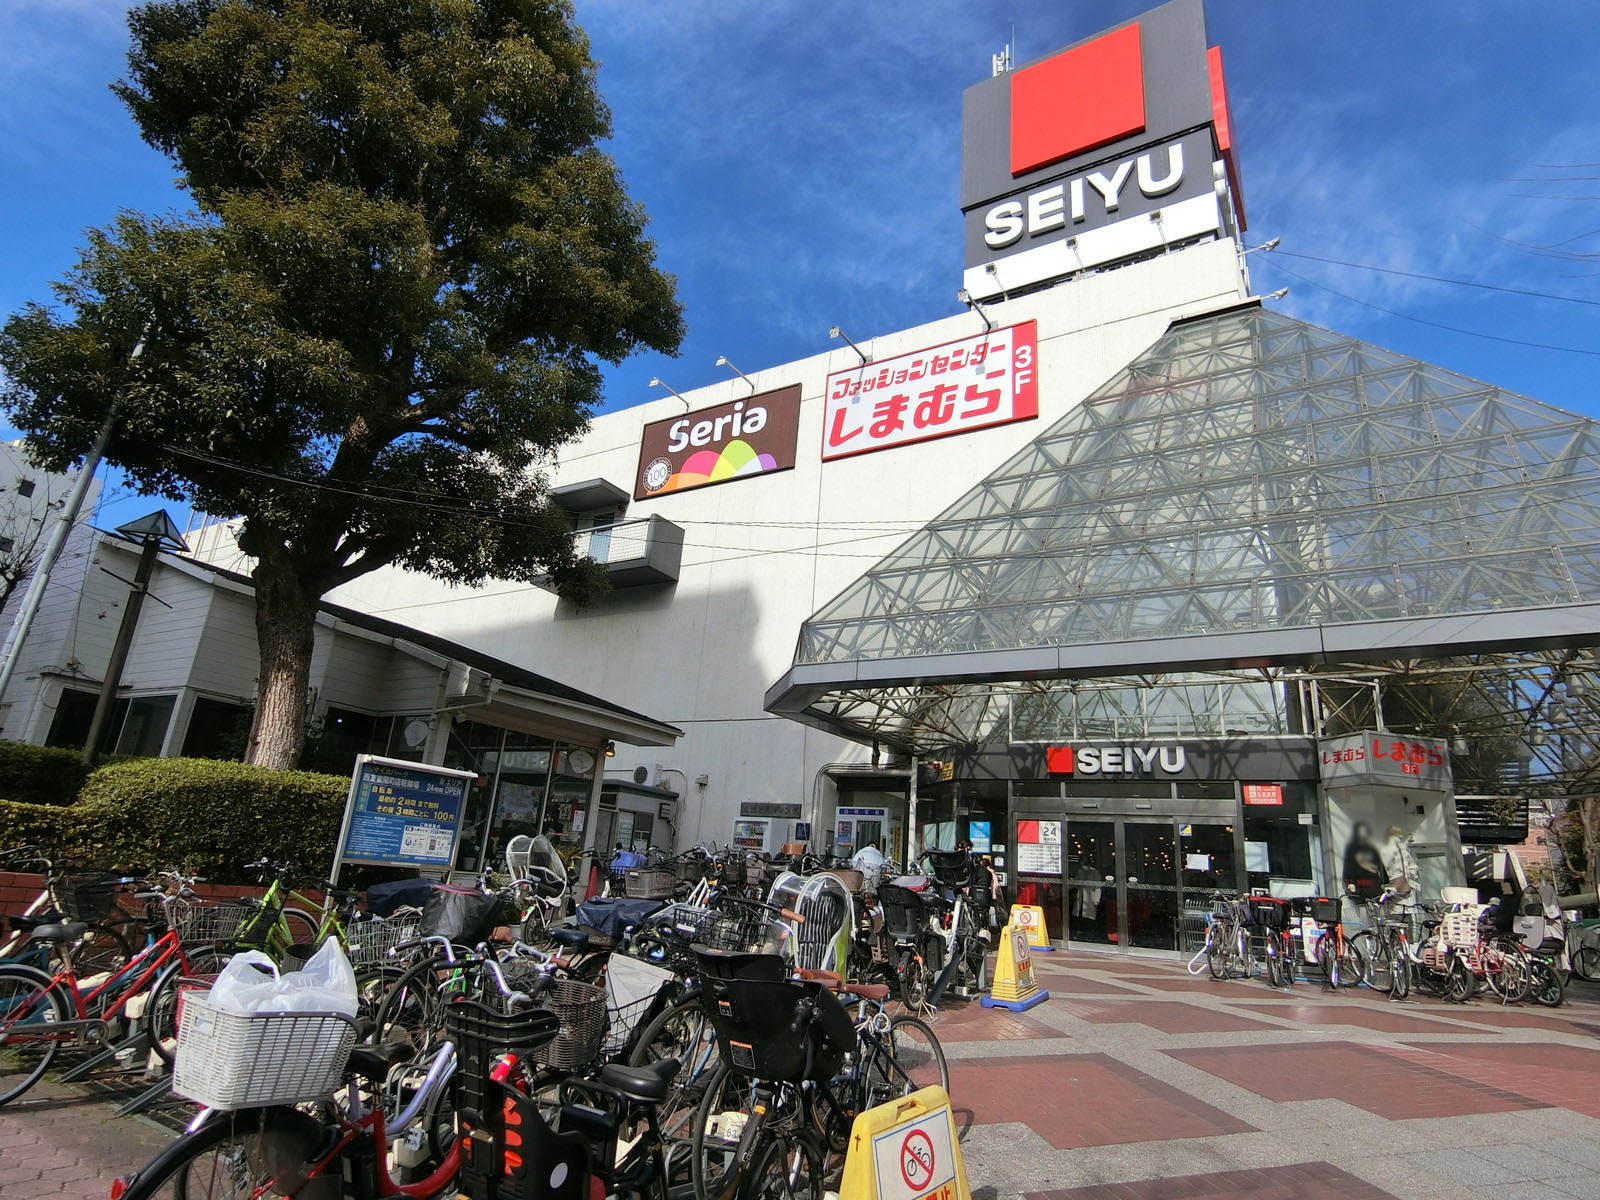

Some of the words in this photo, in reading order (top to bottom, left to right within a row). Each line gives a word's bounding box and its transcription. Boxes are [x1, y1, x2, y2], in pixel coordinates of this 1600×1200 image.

[984, 143, 1184, 248] SEIYU
[832, 342, 1006, 400] ファッションセンター
[1014, 345, 1032, 394] 3F
[829, 369, 1006, 447] しまむら
[667, 401, 768, 453] Seria
[649, 467, 667, 483] 100
[1077, 746, 1186, 774] SEIYU
[1323, 746, 1365, 765] しまむら
[1373, 738, 1443, 766] しまむら
[1404, 763, 1417, 774] 3F
[444, 786, 461, 796] OPEN
[1043, 826, 1057, 837] 24
[926, 1185, 951, 1200] 止
